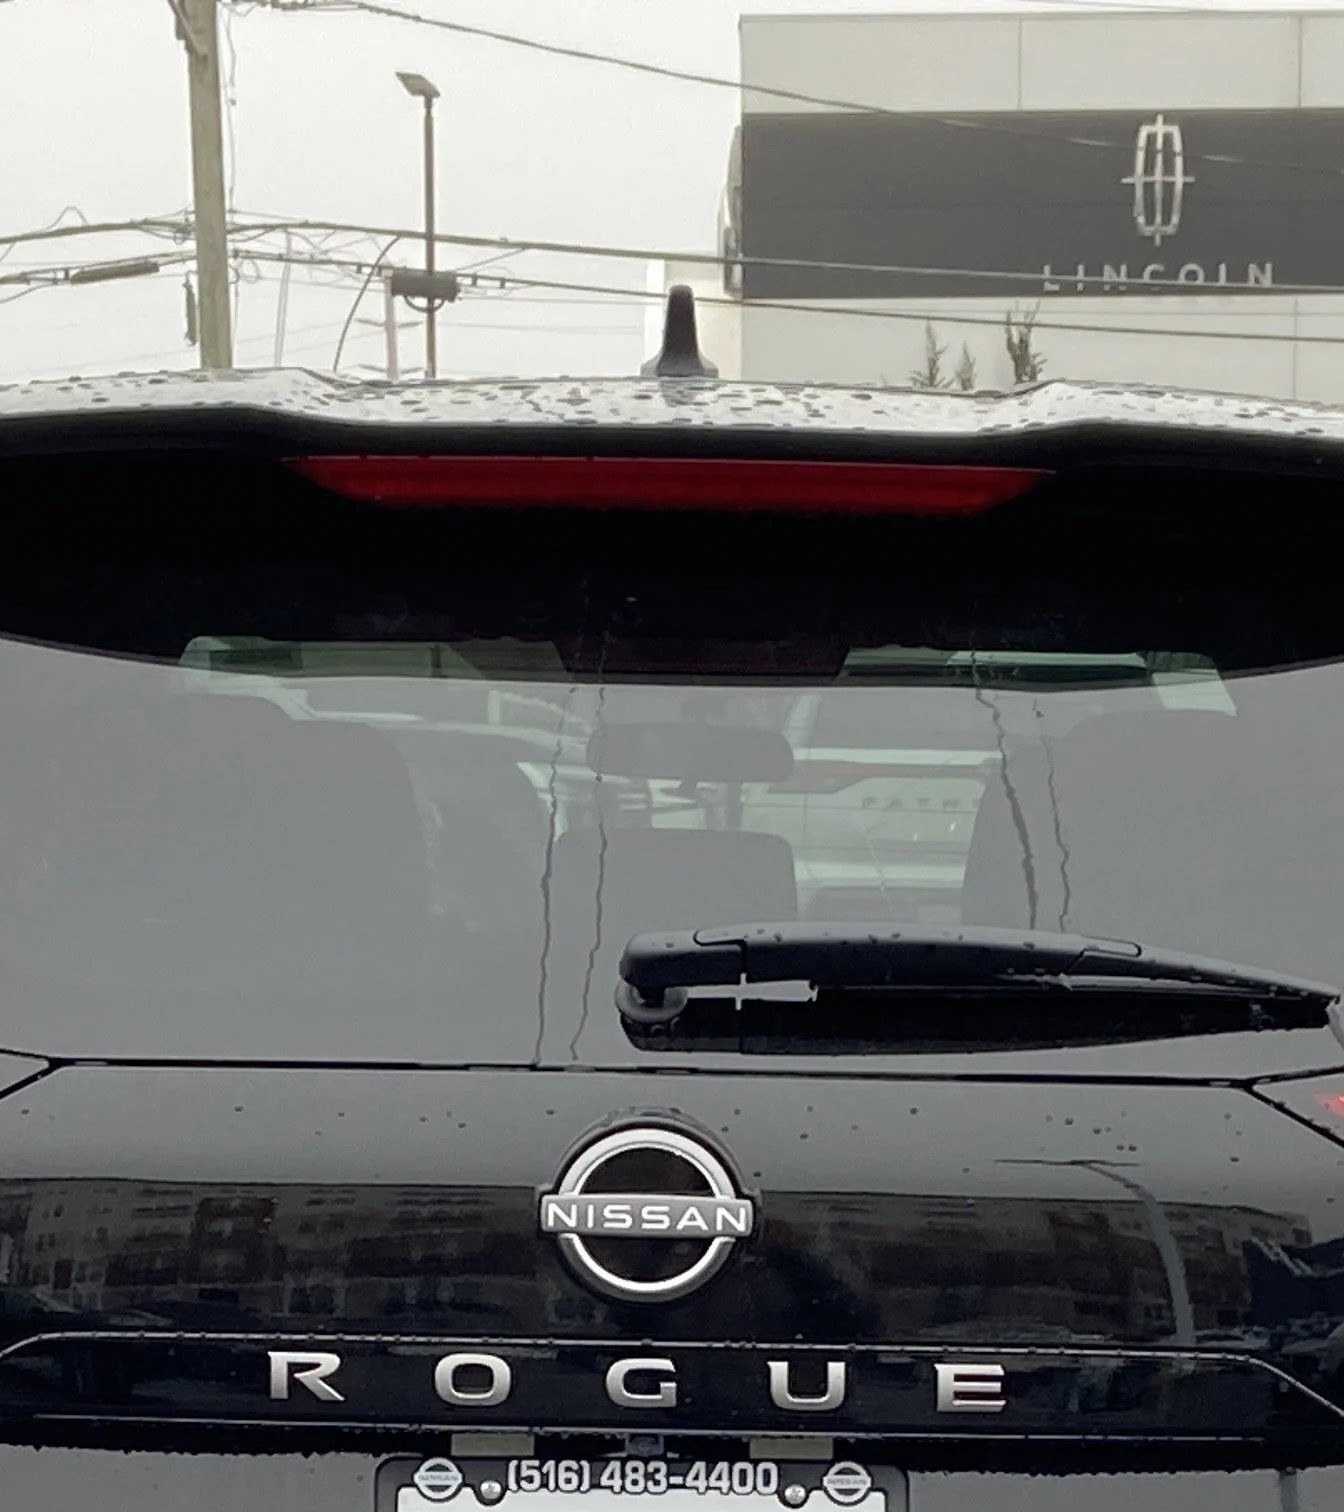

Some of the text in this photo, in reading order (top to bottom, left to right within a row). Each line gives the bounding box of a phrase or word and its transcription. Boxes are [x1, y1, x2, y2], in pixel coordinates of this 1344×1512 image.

[545, 1201, 749, 1234] NISSAN
[268, 1350, 1008, 1412] ROGUE
[507, 1459, 779, 1495] (516) 483-4400
